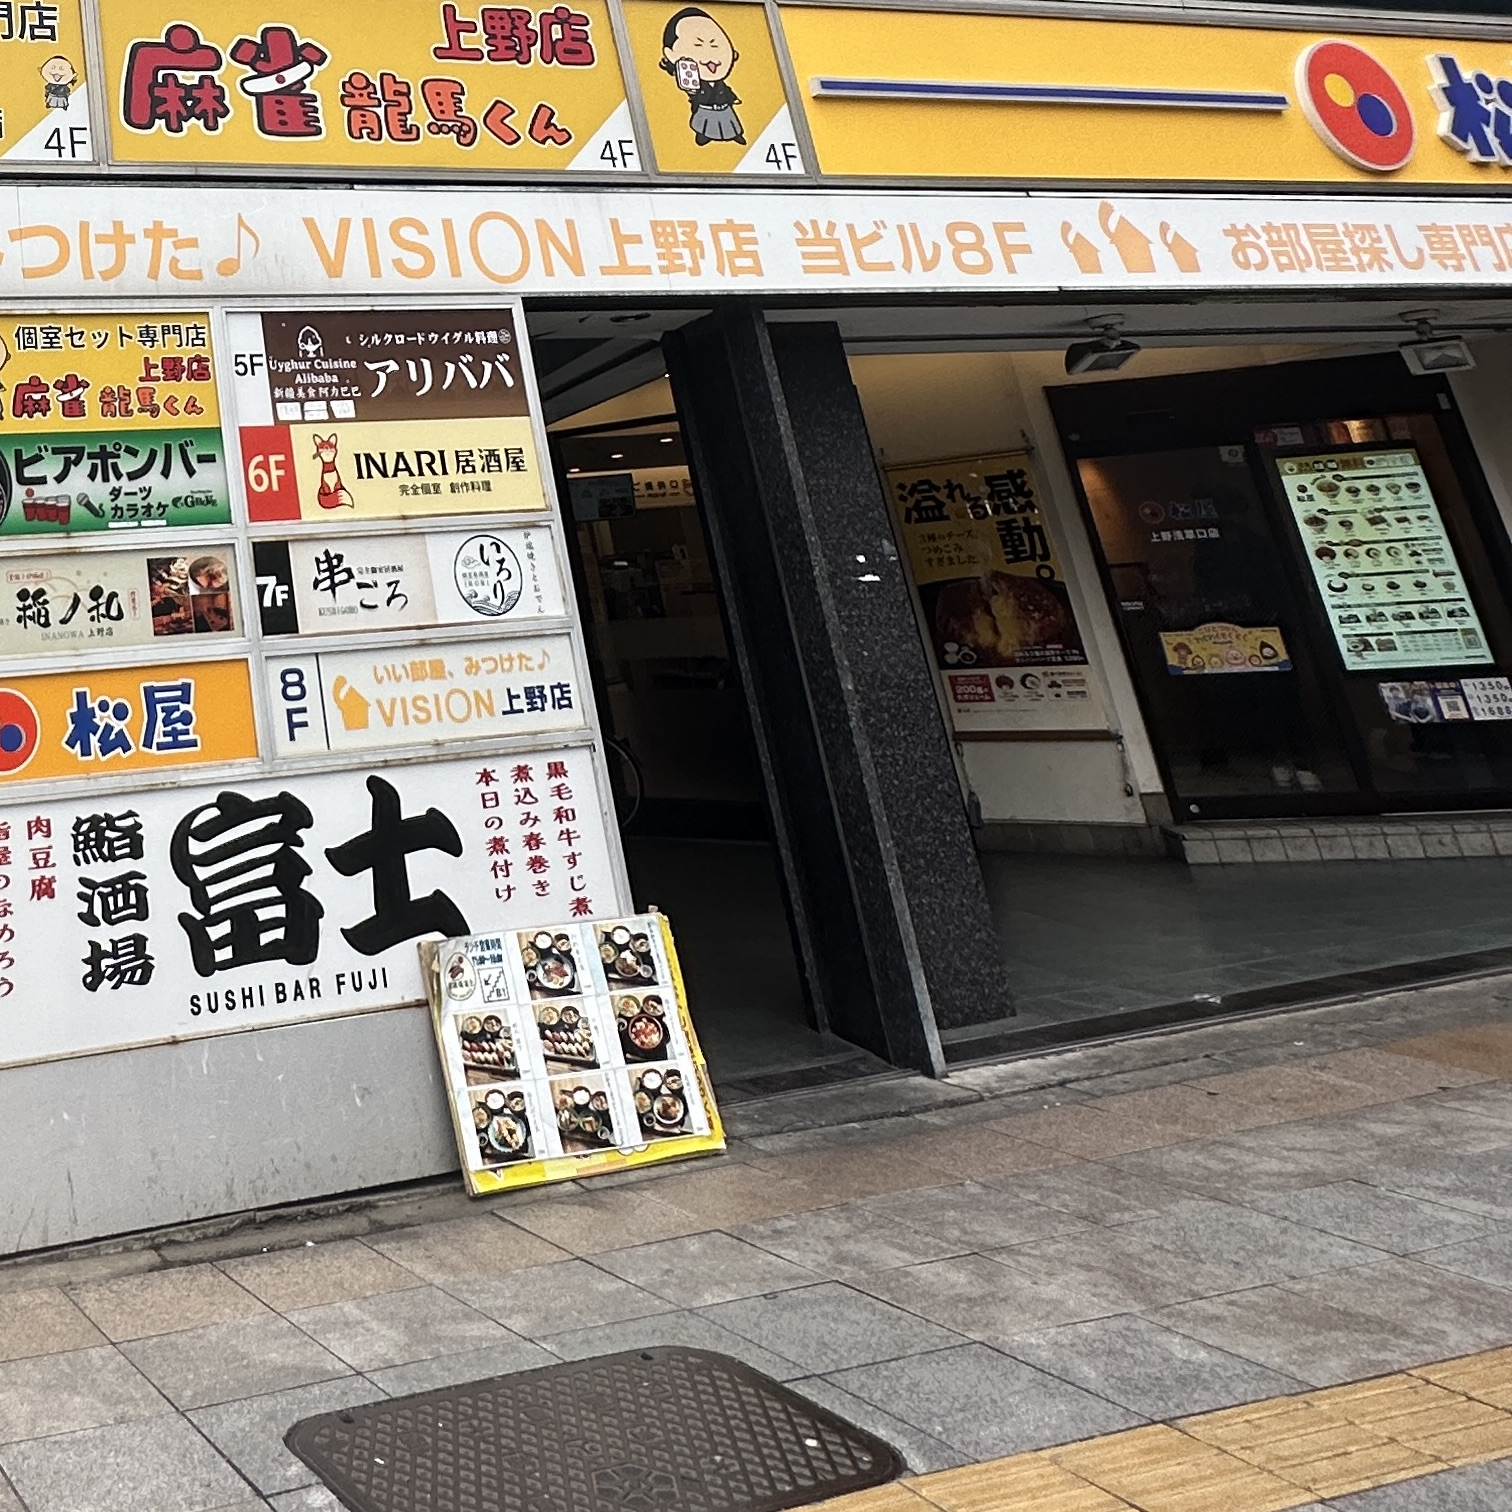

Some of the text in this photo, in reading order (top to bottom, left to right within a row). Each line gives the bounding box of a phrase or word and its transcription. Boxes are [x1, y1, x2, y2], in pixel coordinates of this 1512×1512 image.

[433, 1, 598, 68] 上野店
[120, 22, 574, 148] 麻雀 龍馬くん
[44, 126, 88, 159] 4F
[600, 139, 635, 170] 4F
[765, 142, 798, 172] 4F
[14, 324, 208, 352] 個室セット専門店
[137, 355, 212, 384] 上野店
[234, 352, 265, 378] 5F
[294, 372, 340, 385] Alibaba
[313, 357, 358, 369] Cuisine
[363, 351, 516, 399] アリババ
[10, 373, 206, 420] 麻雀 龍馬くん
[14, 440, 218, 487] ビアポンバー
[248, 454, 287, 494] 6F
[354, 448, 529, 481] INARI 居酒屋
[108, 486, 154, 503] ダーツ
[110, 502, 171, 521] カラオケ
[256, 576, 290, 608] 7F
[313, 548, 409, 612] 串ごろ
[479, 541, 513, 609] いろり
[64, 681, 201, 758] 松屋
[280, 667, 310, 742] 8F
[476, 767, 515, 902] 本日の煮付け
[511, 764, 550, 897] 煮込み春巻き
[546, 761, 594, 917] 黒毛和牛すじ煮
[26, 816, 57, 901] 肉豆腐
[170, 775, 472, 977] 富士
[70, 810, 155, 992] 鮨酒場
[190, 967, 389, 1017] SUSHI BAR FUJI
